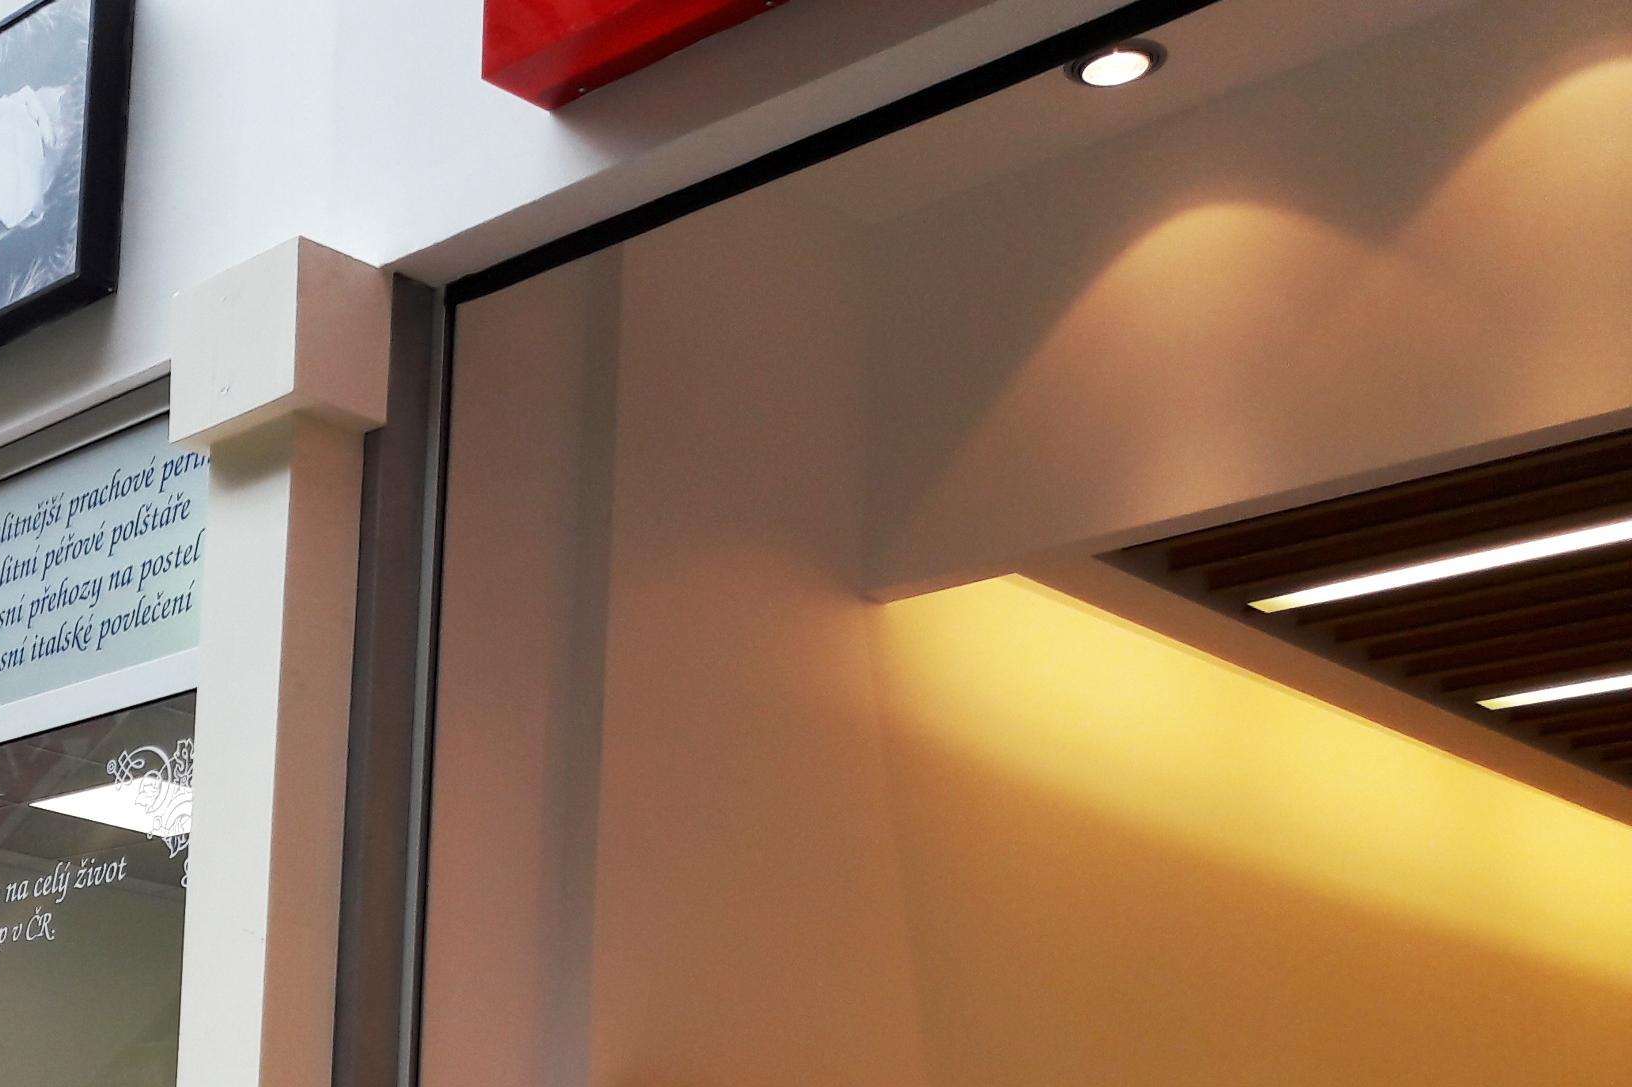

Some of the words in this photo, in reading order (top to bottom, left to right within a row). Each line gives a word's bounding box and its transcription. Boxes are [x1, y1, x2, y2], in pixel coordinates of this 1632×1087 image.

[66, 456, 156, 529] prachové
[41, 521, 105, 581] péřové
[108, 491, 191, 557] polštáře
[28, 576, 103, 629] přehozy
[108, 566, 133, 591] na
[137, 528, 206, 592] postel
[30, 614, 94, 662] italské
[96, 580, 195, 651] povlečení
[6, 881, 28, 903] na
[34, 861, 71, 903] celý
[74, 856, 127, 889] život
[12, 923, 23, 942] v
[25, 906, 55, 941] ČR.
